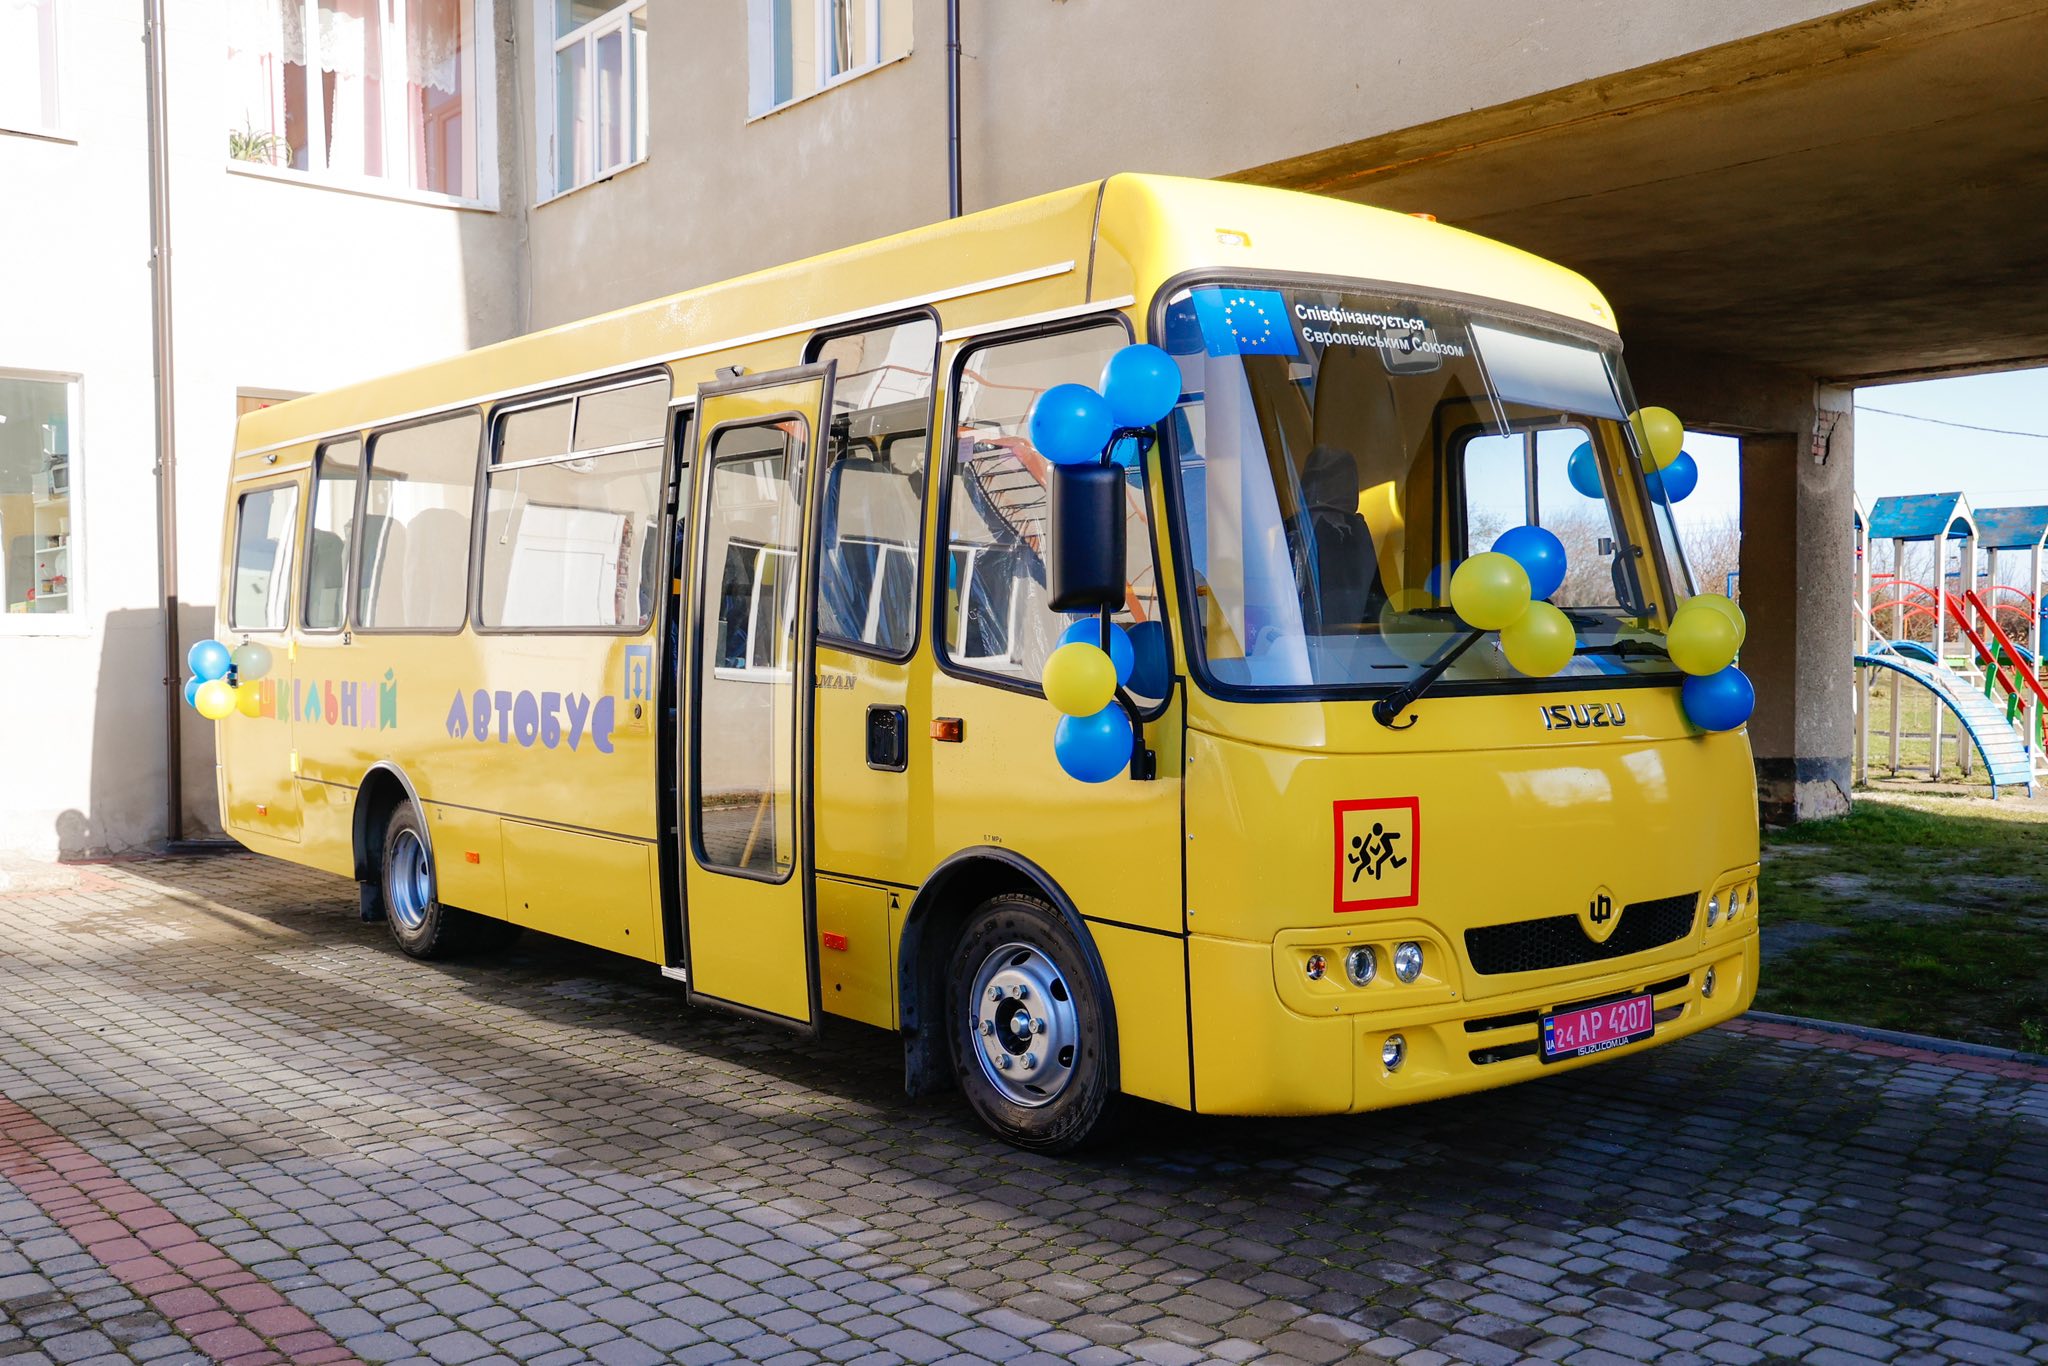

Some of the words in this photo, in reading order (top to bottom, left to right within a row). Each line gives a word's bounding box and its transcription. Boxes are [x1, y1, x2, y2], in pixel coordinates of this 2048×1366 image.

[1295, 304, 1426, 331] Співфінансується
[1302, 326, 1410, 351] Європейським
[1412, 337, 1465, 357] Союзом
[815, 674, 857, 689] MAN
[445, 688, 615, 754] АВТОБУС
[1540, 703, 1626, 730] ISUZU
[1556, 1025, 1575, 1049] 24
[1578, 1011, 1603, 1043] AP
[1609, 1000, 1646, 1033] 4207
[1546, 1040, 1555, 1050] UA
[1578, 1037, 1629, 1056] ISUZU.COM.UA
